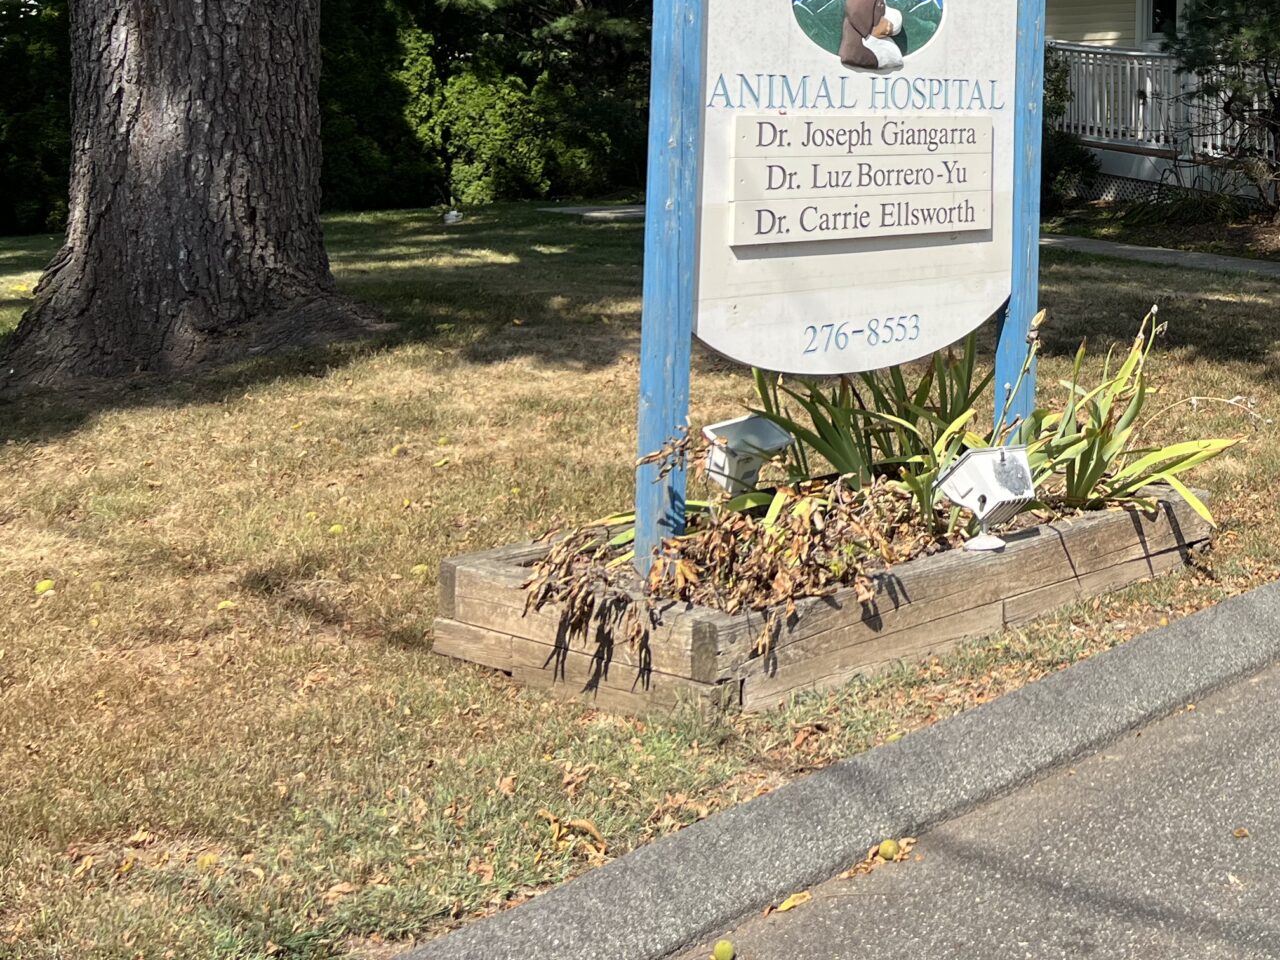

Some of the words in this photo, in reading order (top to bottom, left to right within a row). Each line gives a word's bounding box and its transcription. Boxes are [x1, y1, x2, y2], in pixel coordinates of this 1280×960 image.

[706, 73, 858, 109] ANIMAL
[868, 76, 1006, 111] HOSPITAL
[755, 121, 791, 147] Dr.
[801, 120, 873, 154] Joseph
[881, 121, 977, 152] Giangarra
[766, 164, 801, 190] Dr.
[810, 163, 851, 189] Luz
[857, 160, 968, 186] Borrero-Yu
[754, 208, 790, 235] Dr.
[800, 204, 871, 232] Carrie
[879, 199, 976, 228] Ellsworth
[802, 314, 921, 355] 276-8553
